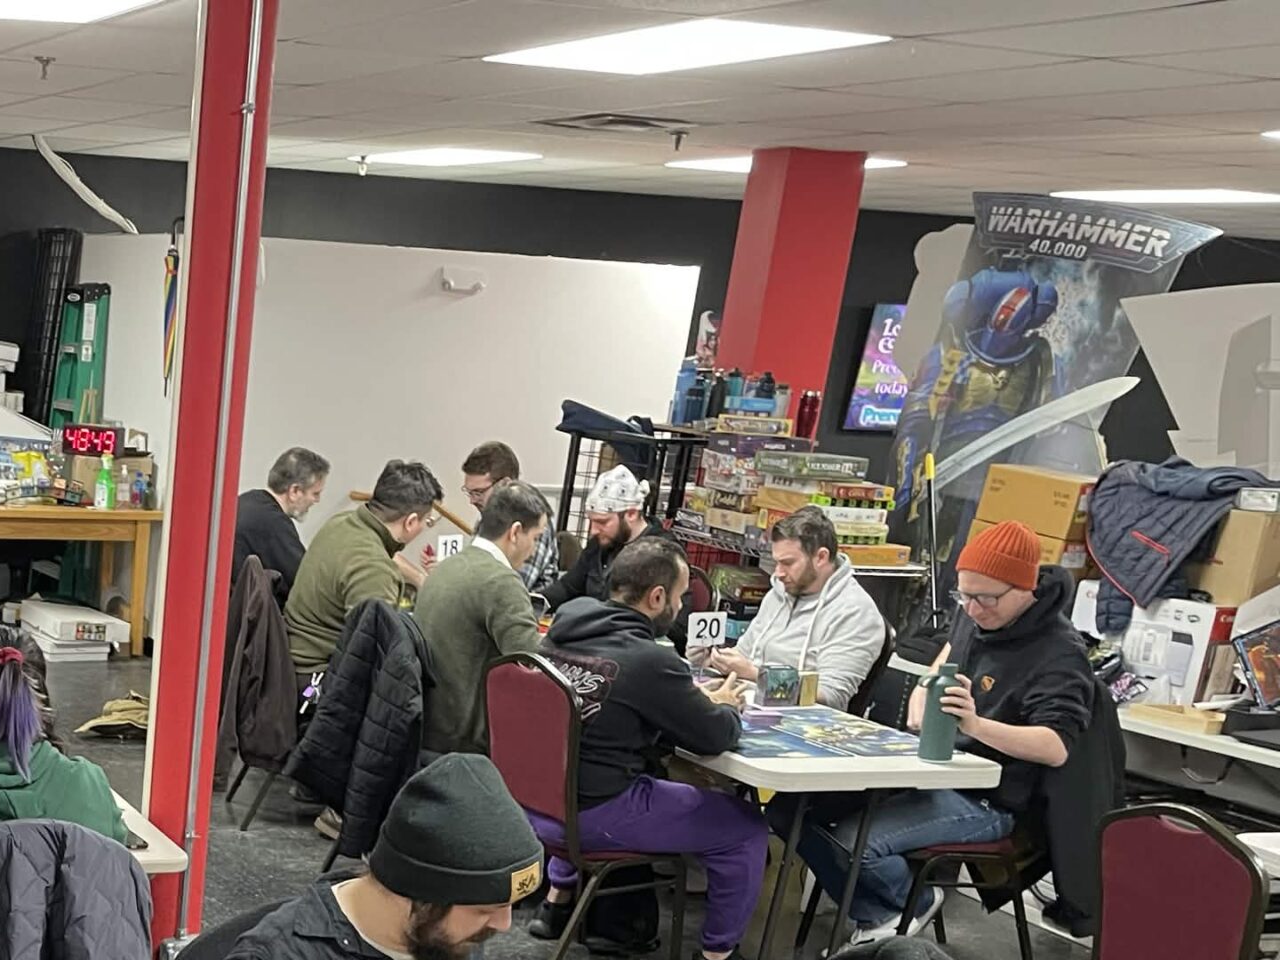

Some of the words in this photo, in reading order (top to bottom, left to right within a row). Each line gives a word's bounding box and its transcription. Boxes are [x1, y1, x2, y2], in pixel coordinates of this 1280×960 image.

[988, 206, 1172, 258] WARHAMMER
[442, 540, 458, 556] 18
[696, 618, 720, 639] 20
